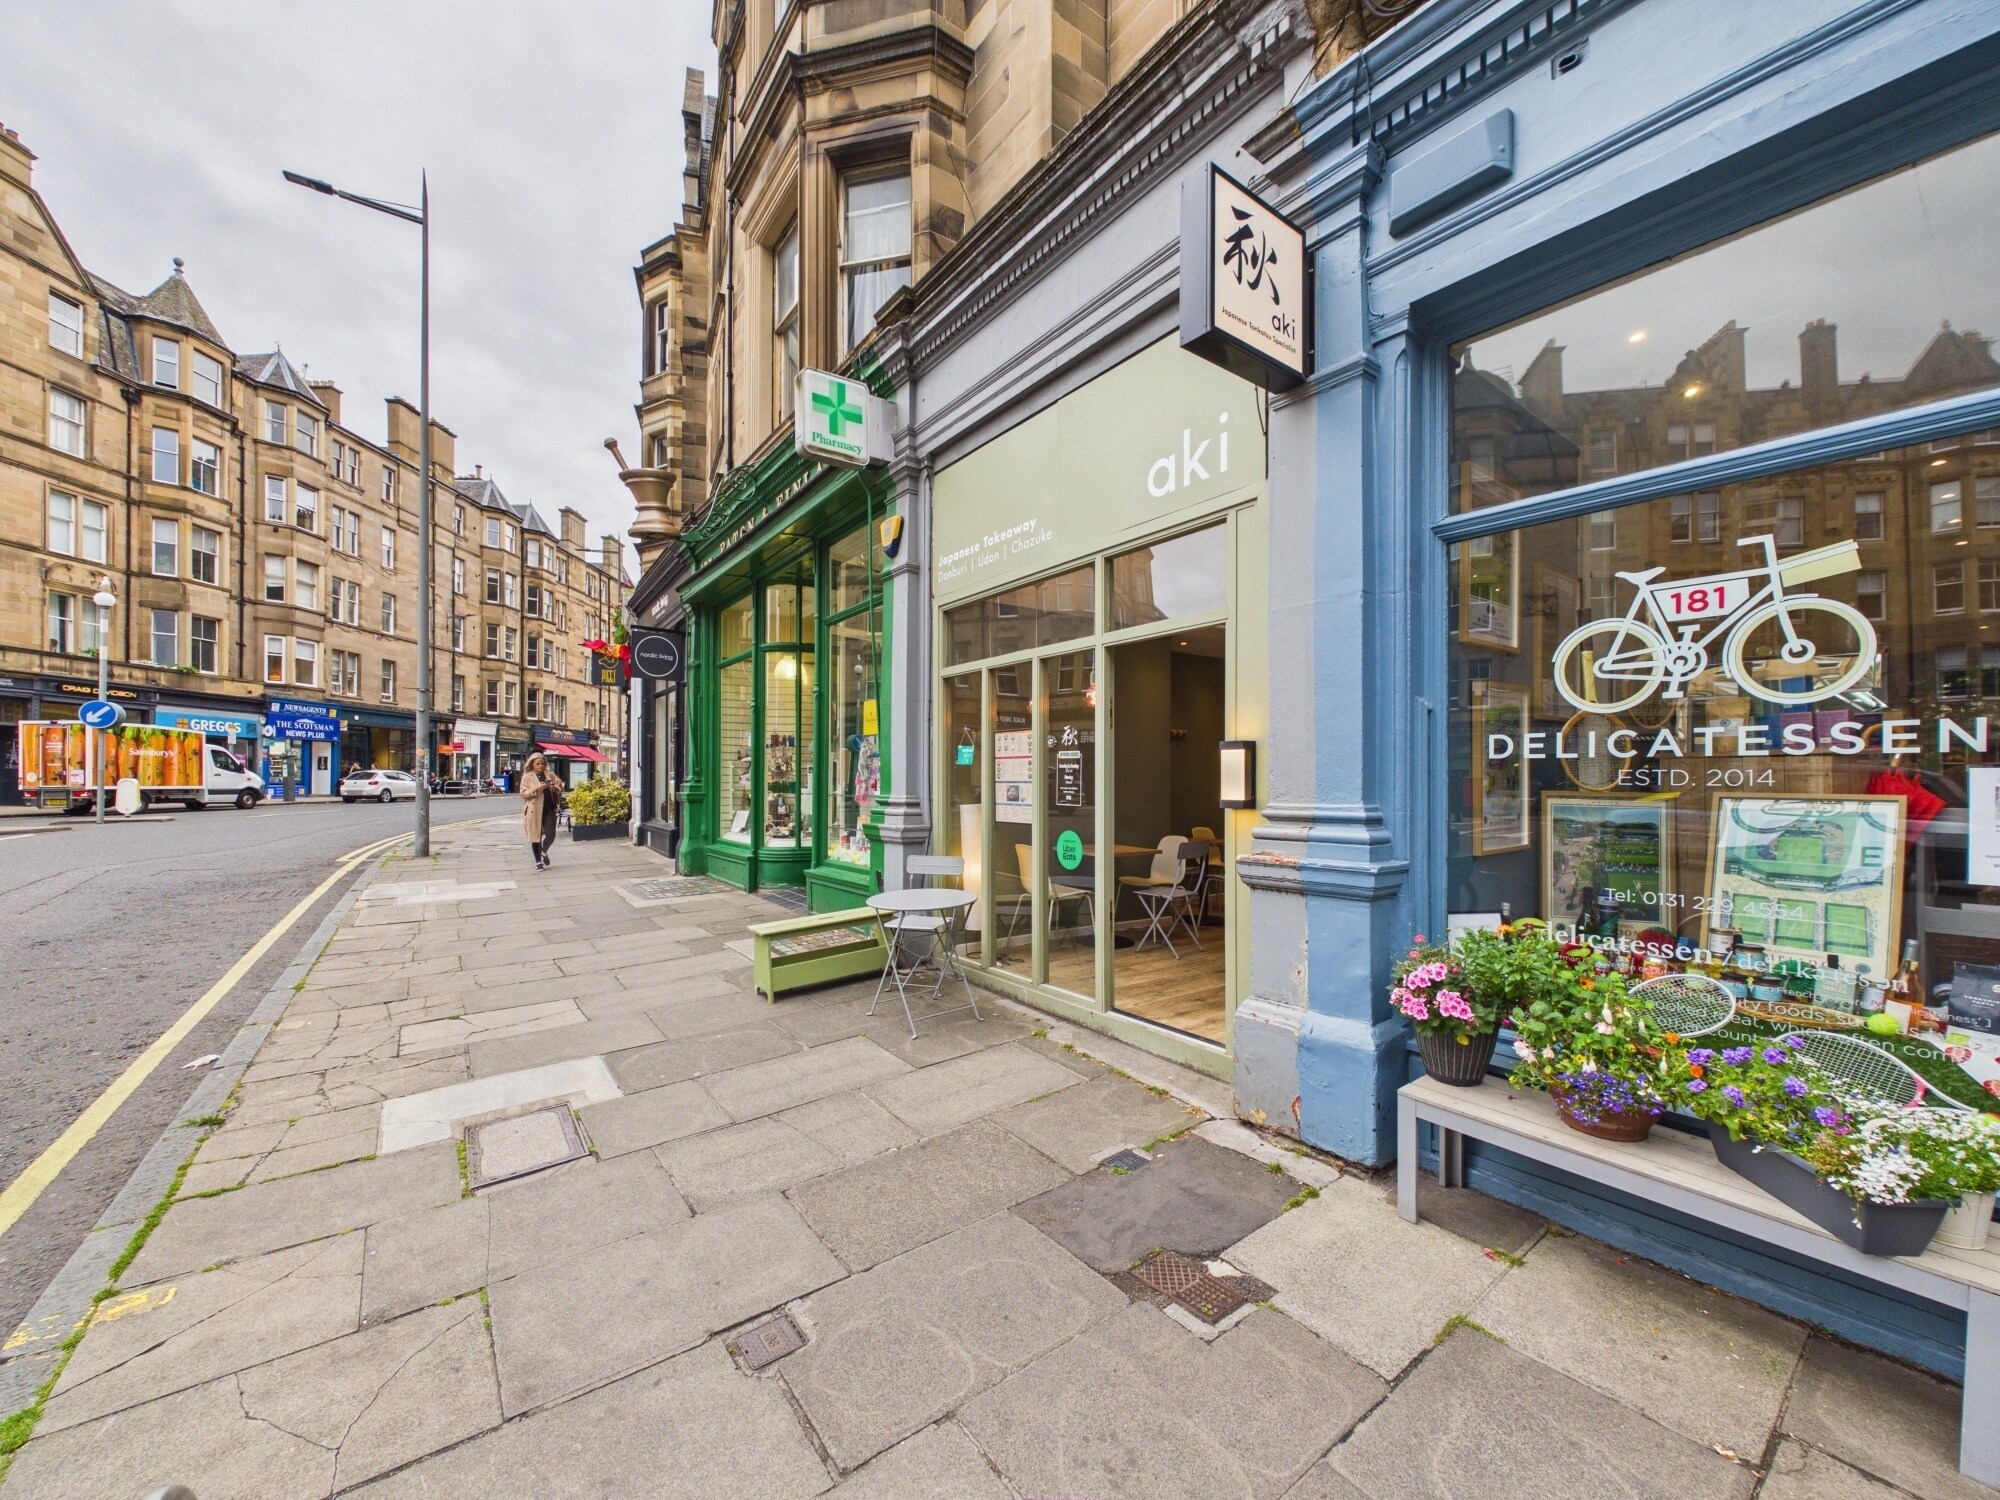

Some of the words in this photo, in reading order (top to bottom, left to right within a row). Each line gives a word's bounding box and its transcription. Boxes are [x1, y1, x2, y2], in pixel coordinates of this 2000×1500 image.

[1223, 205, 1280, 306] 秋
[1221, 306, 1247, 326] Japanese
[1273, 336, 1296, 353] Specialist
[1272, 313, 1295, 340] aki
[812, 431, 862, 455] Pharmacy
[1147, 412, 1228, 497] aki
[939, 543, 980, 567] Japanese
[983, 518, 1037, 548] Takeaway
[938, 561, 967, 582] Donburi
[978, 551, 999, 567] Udon
[1011, 528, 1052, 553] Chazuke
[1670, 585, 1727, 614] 181
[659, 653, 673, 661] living
[62, 684, 91, 694] CRAIG
[93, 688, 137, 698] DVIDSON
[284, 704, 327, 714] NEWSAGENTS
[276, 720, 292, 728] THE
[294, 721, 334, 732] SCOTSMAN
[285, 729, 306, 738] NEWS
[308, 731, 325, 739] PLUS
[1488, 717, 1988, 760] DELICATESSEN
[128, 748, 177, 758] Sainsbury's
[1618, 769, 1695, 787] ESTD.
[1706, 768, 1776, 787] 2014
[1063, 844, 1076, 853] Uber
[1063, 852, 1076, 861] Eats
[1604, 887, 1636, 903] Tel:
[1643, 891, 1685, 908] 0131
[1692, 896, 1733, 913] 229
[1743, 901, 1805, 919] 4554
[1540, 921, 1713, 965] delicatessen
[1767, 1000, 1829, 1023] foods,
